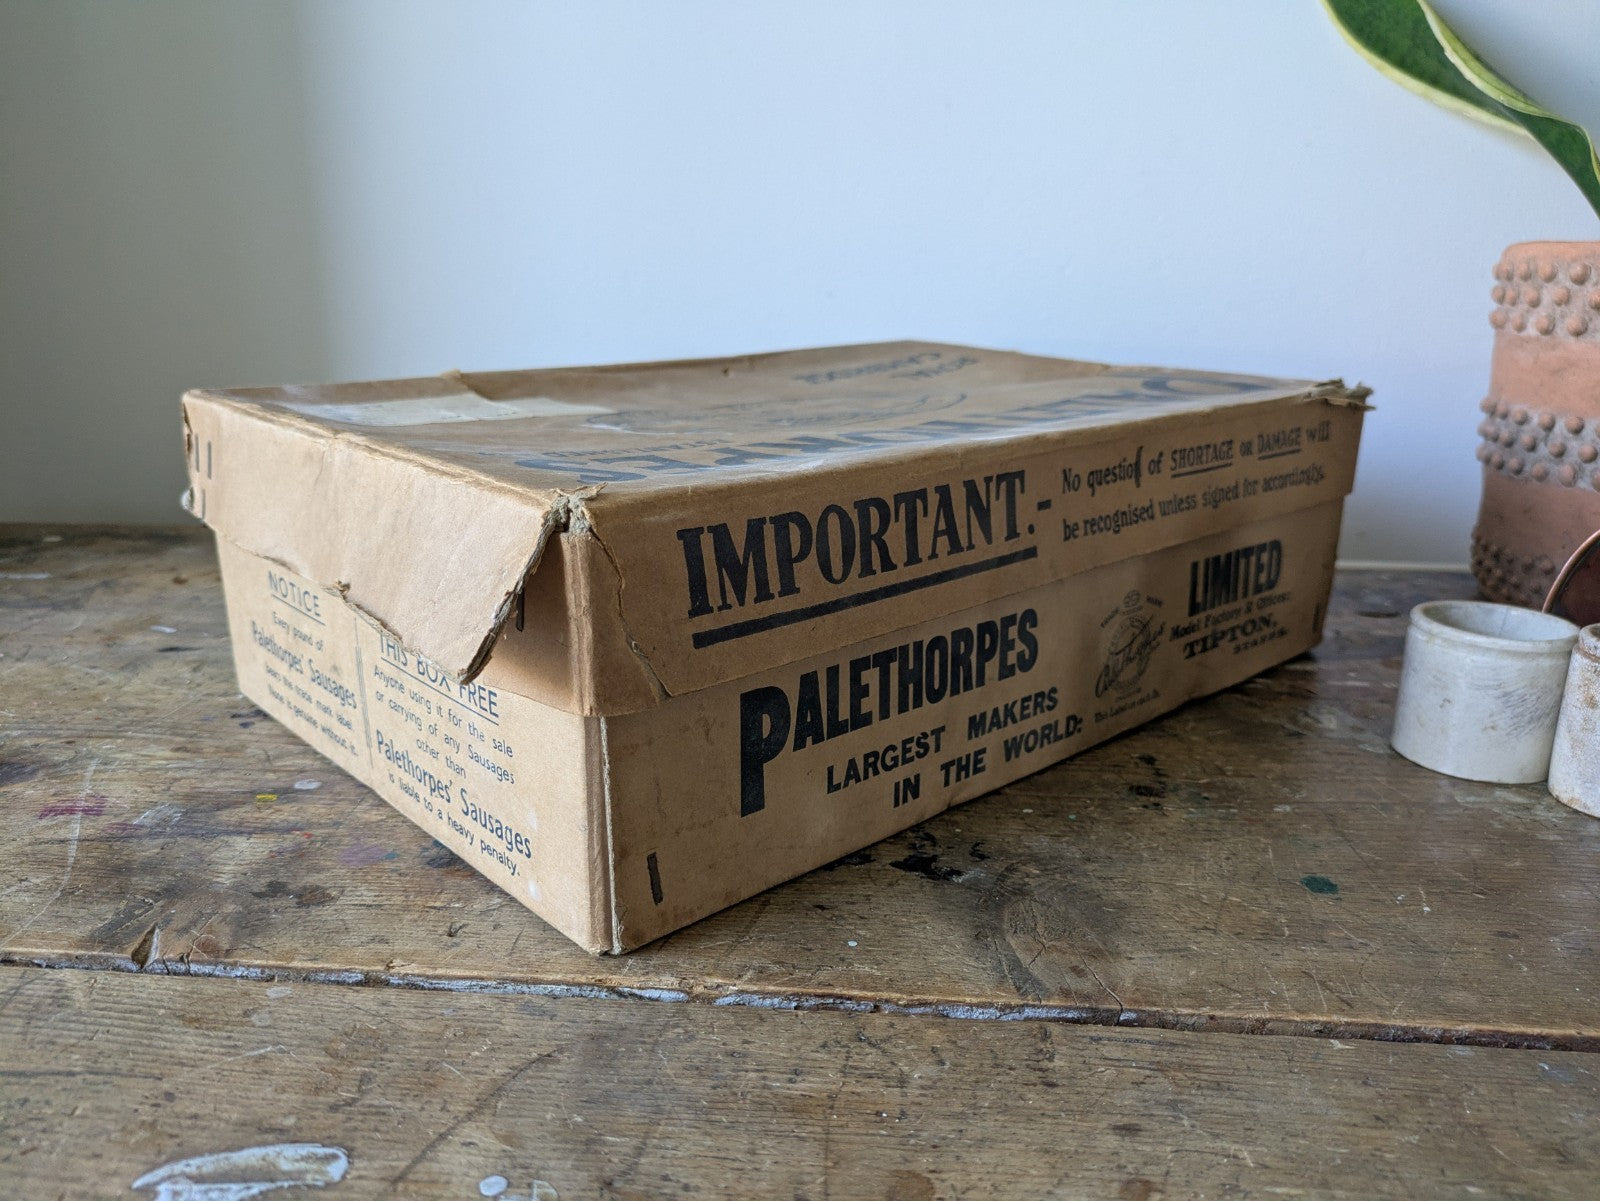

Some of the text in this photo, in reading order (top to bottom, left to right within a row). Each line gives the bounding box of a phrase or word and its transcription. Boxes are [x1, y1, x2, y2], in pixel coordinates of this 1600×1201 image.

[1061, 467, 1081, 494] No
[1148, 450, 1164, 475] of
[1169, 439, 1233, 472] SHORTAGE
[1257, 427, 1302, 454] DAMAGE
[1063, 518, 1080, 542] be
[1083, 498, 1155, 535] recognised
[1159, 494, 1197, 518] unless
[1201, 480, 1239, 509] signed
[1242, 478, 1258, 498] for
[268, 570, 321, 617] NOTICE
[1188, 539, 1283, 617] LIMITED
[308, 658, 357, 710] Sausages
[374, 665, 513, 758] Anyone using it for the sale
[740, 608, 1038, 818] PALETHORPES
[376, 690, 515, 784] or carrying of any Sausages
[416, 738, 467, 779] other than
[827, 725, 946, 794] LARGEST
[967, 687, 1059, 740] MAKERS
[388, 769, 395, 783] is
[399, 777, 420, 802] liable
[423, 797, 433, 812] to
[437, 809, 443, 820] a
[447, 811, 475, 845] heavy
[893, 773, 921, 808] IN
[940, 748, 986, 788] THE
[460, 788, 532, 859] Sausages
